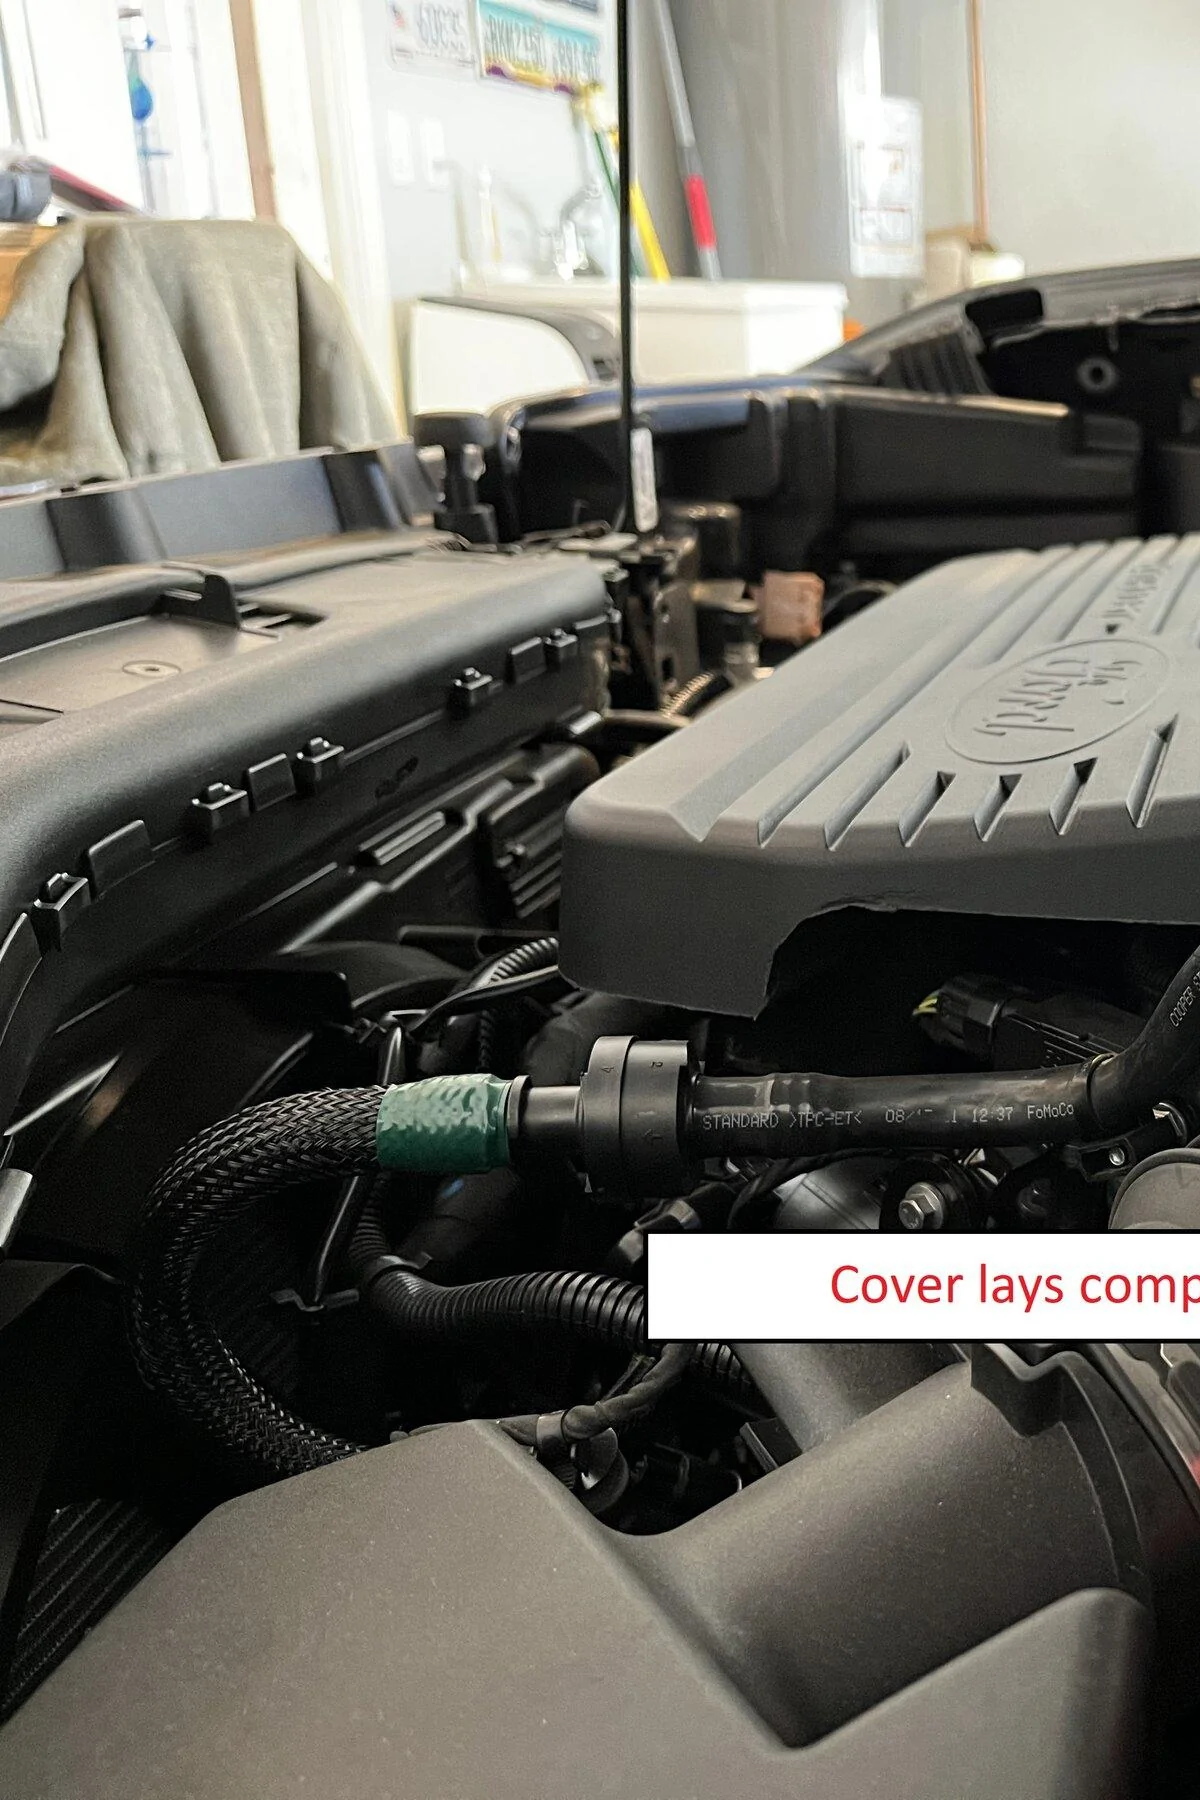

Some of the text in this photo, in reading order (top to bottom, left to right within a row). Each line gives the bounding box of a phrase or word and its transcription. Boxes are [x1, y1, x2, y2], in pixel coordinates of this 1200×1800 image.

[1169, 985, 1197, 1028] COOPER
[702, 1112, 780, 1131] STANDARD
[1027, 1102, 1075, 1120] FoMoCo
